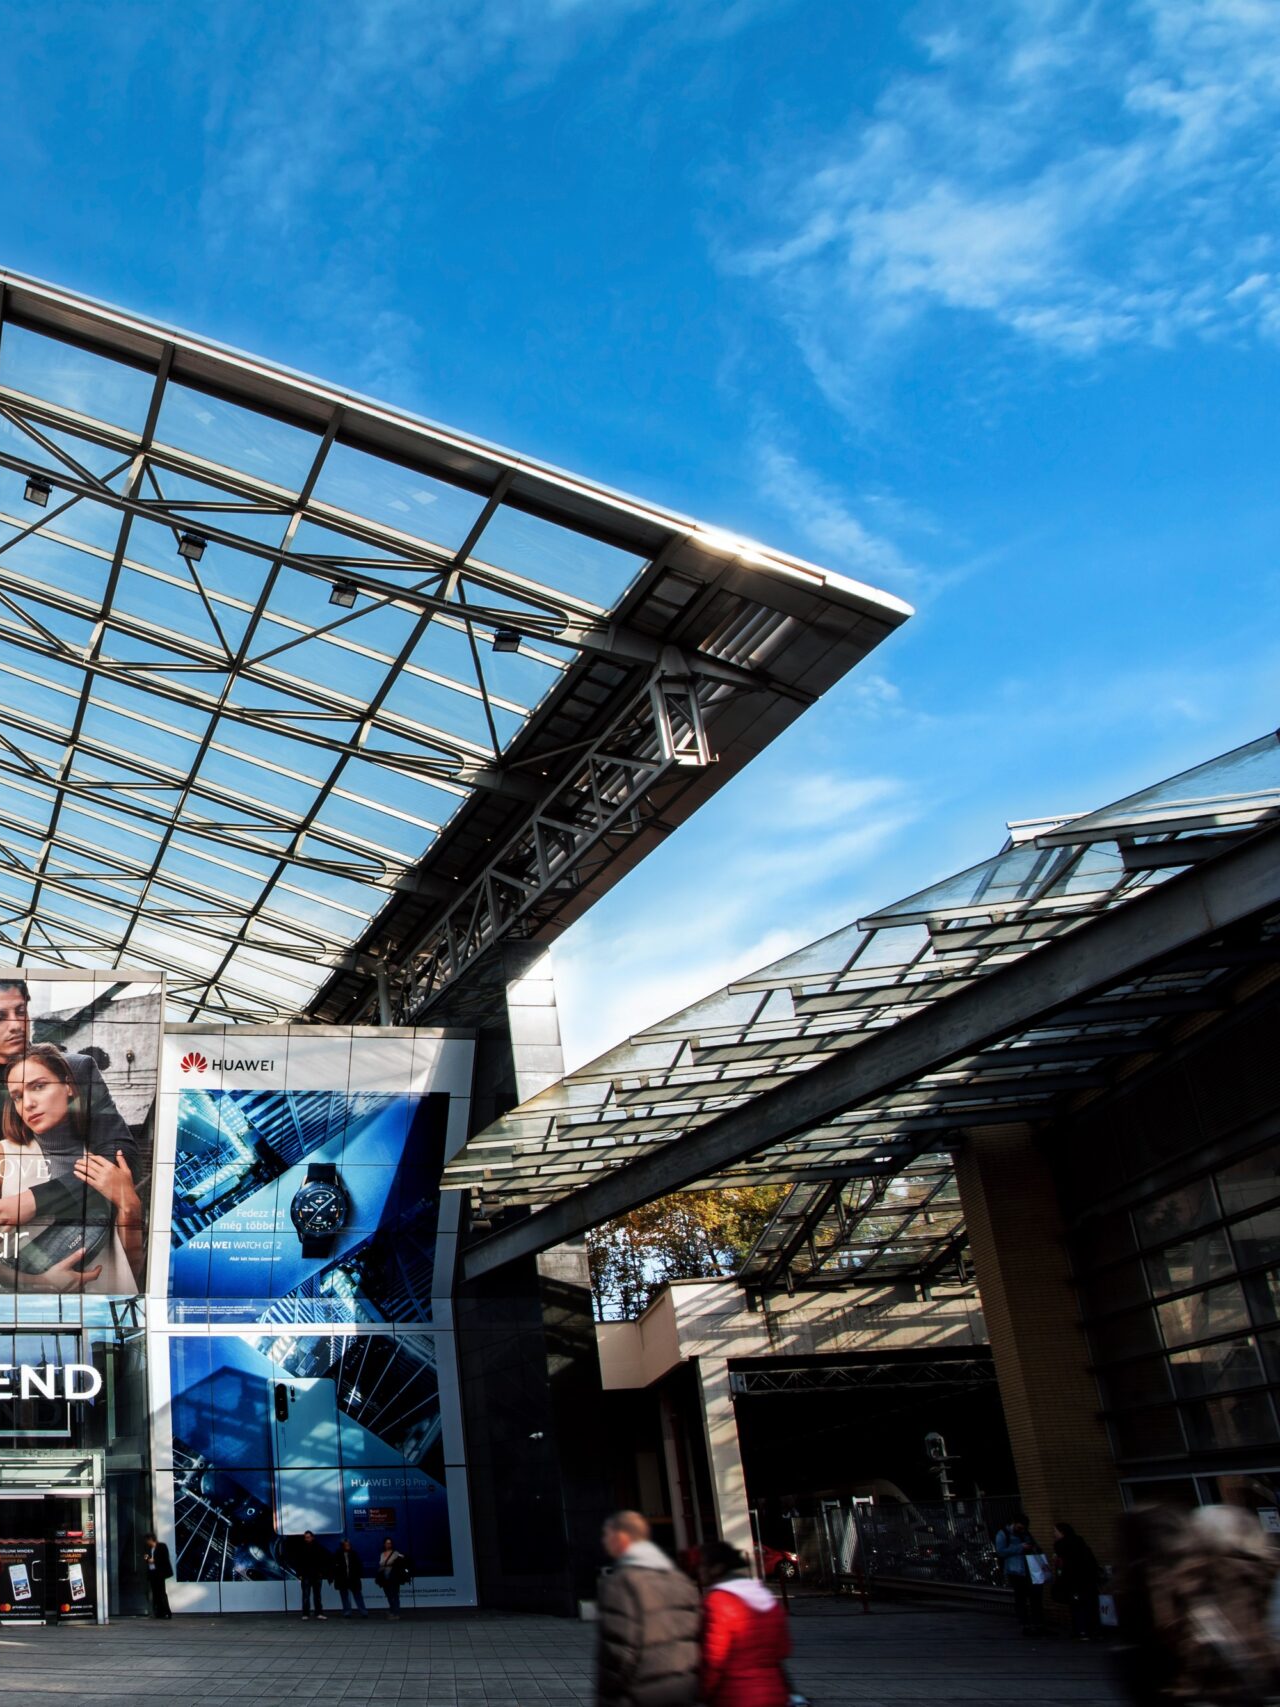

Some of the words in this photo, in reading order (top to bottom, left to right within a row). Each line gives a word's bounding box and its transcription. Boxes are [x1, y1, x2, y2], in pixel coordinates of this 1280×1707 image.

[212, 1059, 274, 1071] HUAWEI
[236, 1208, 268, 1218] Fedezz
[271, 1208, 285, 1218] fel
[220, 1222, 242, 1232] még
[246, 1221, 284, 1230] többet!
[188, 1241, 232, 1249] HUAWEI
[233, 1241, 261, 1249] WATCH
[262, 1241, 273, 1249] GT
[276, 1241, 282, 1249] 2
[351, 1478, 392, 1487] HUAWEI
[395, 1478, 411, 1487] P30
